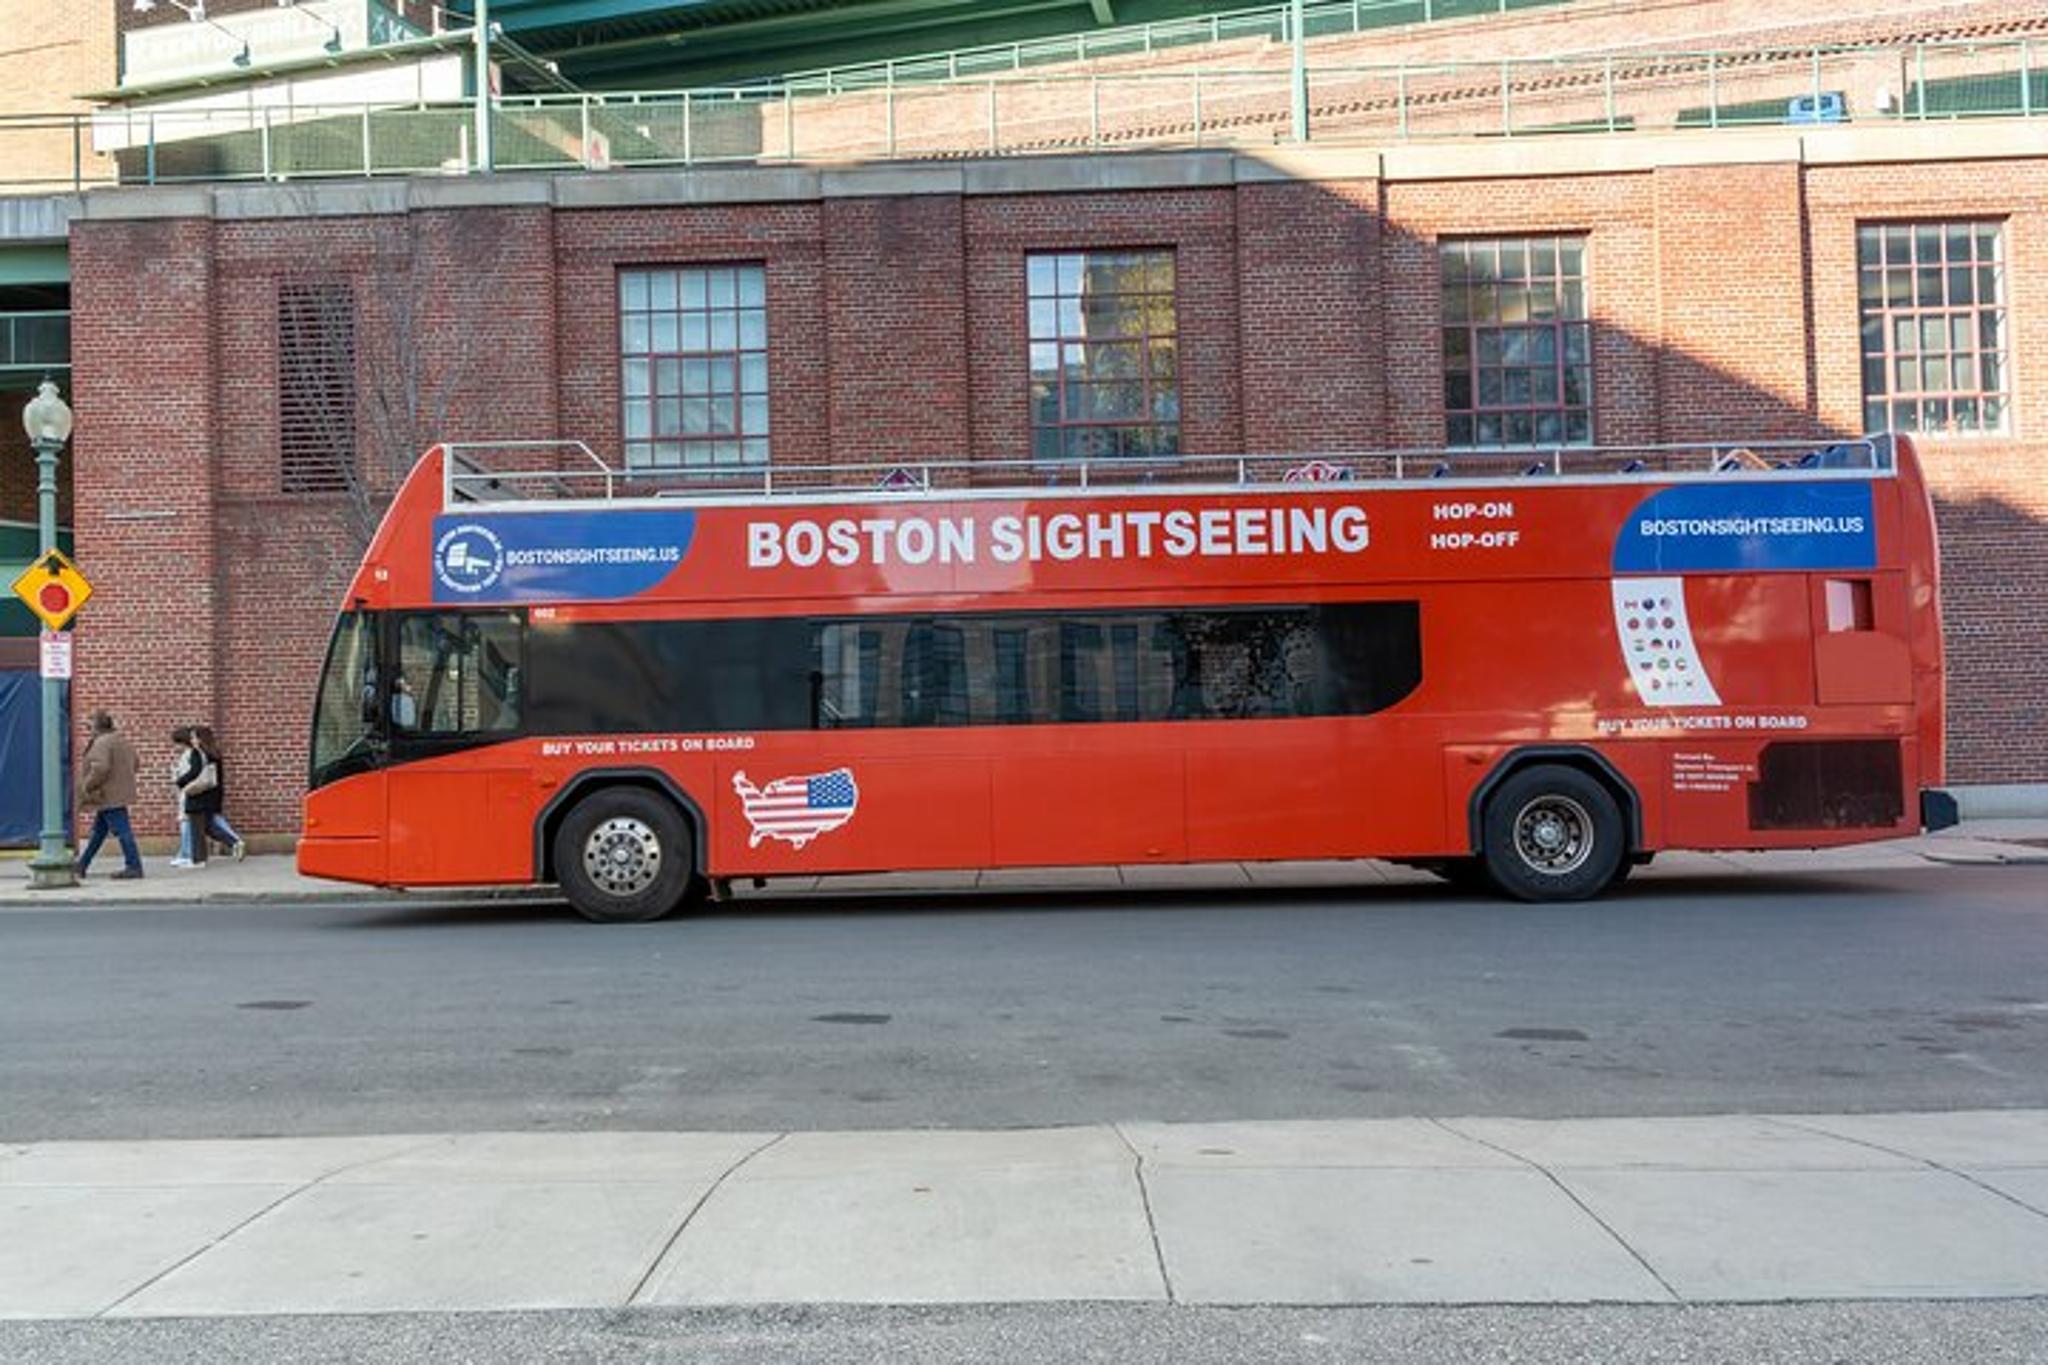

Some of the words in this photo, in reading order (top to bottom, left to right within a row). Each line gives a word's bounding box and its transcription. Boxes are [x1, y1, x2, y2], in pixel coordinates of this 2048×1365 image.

[1433, 503, 1513, 520] HOP-ON
[1640, 516, 1864, 536] BOSTONSIGHTSEEING.US
[746, 518, 976, 568] BOSTON
[990, 506, 1370, 563] SIGHTSEEING
[1431, 532, 1520, 549] HOP-OFF
[506, 547, 680, 565] BOSTONSIGHTSEEING.US
[1597, 717, 1626, 732] BUY
[1631, 717, 1670, 731] YOUR
[1674, 716, 1732, 729] TICKETS
[1735, 716, 1756, 728] ON
[1759, 715, 1808, 728] BOARD
[542, 742, 571, 755] BUY
[576, 741, 615, 754] YOUR
[618, 740, 678, 753] TICKETS
[681, 739, 703, 751] ON
[706, 737, 755, 751] BOARD
